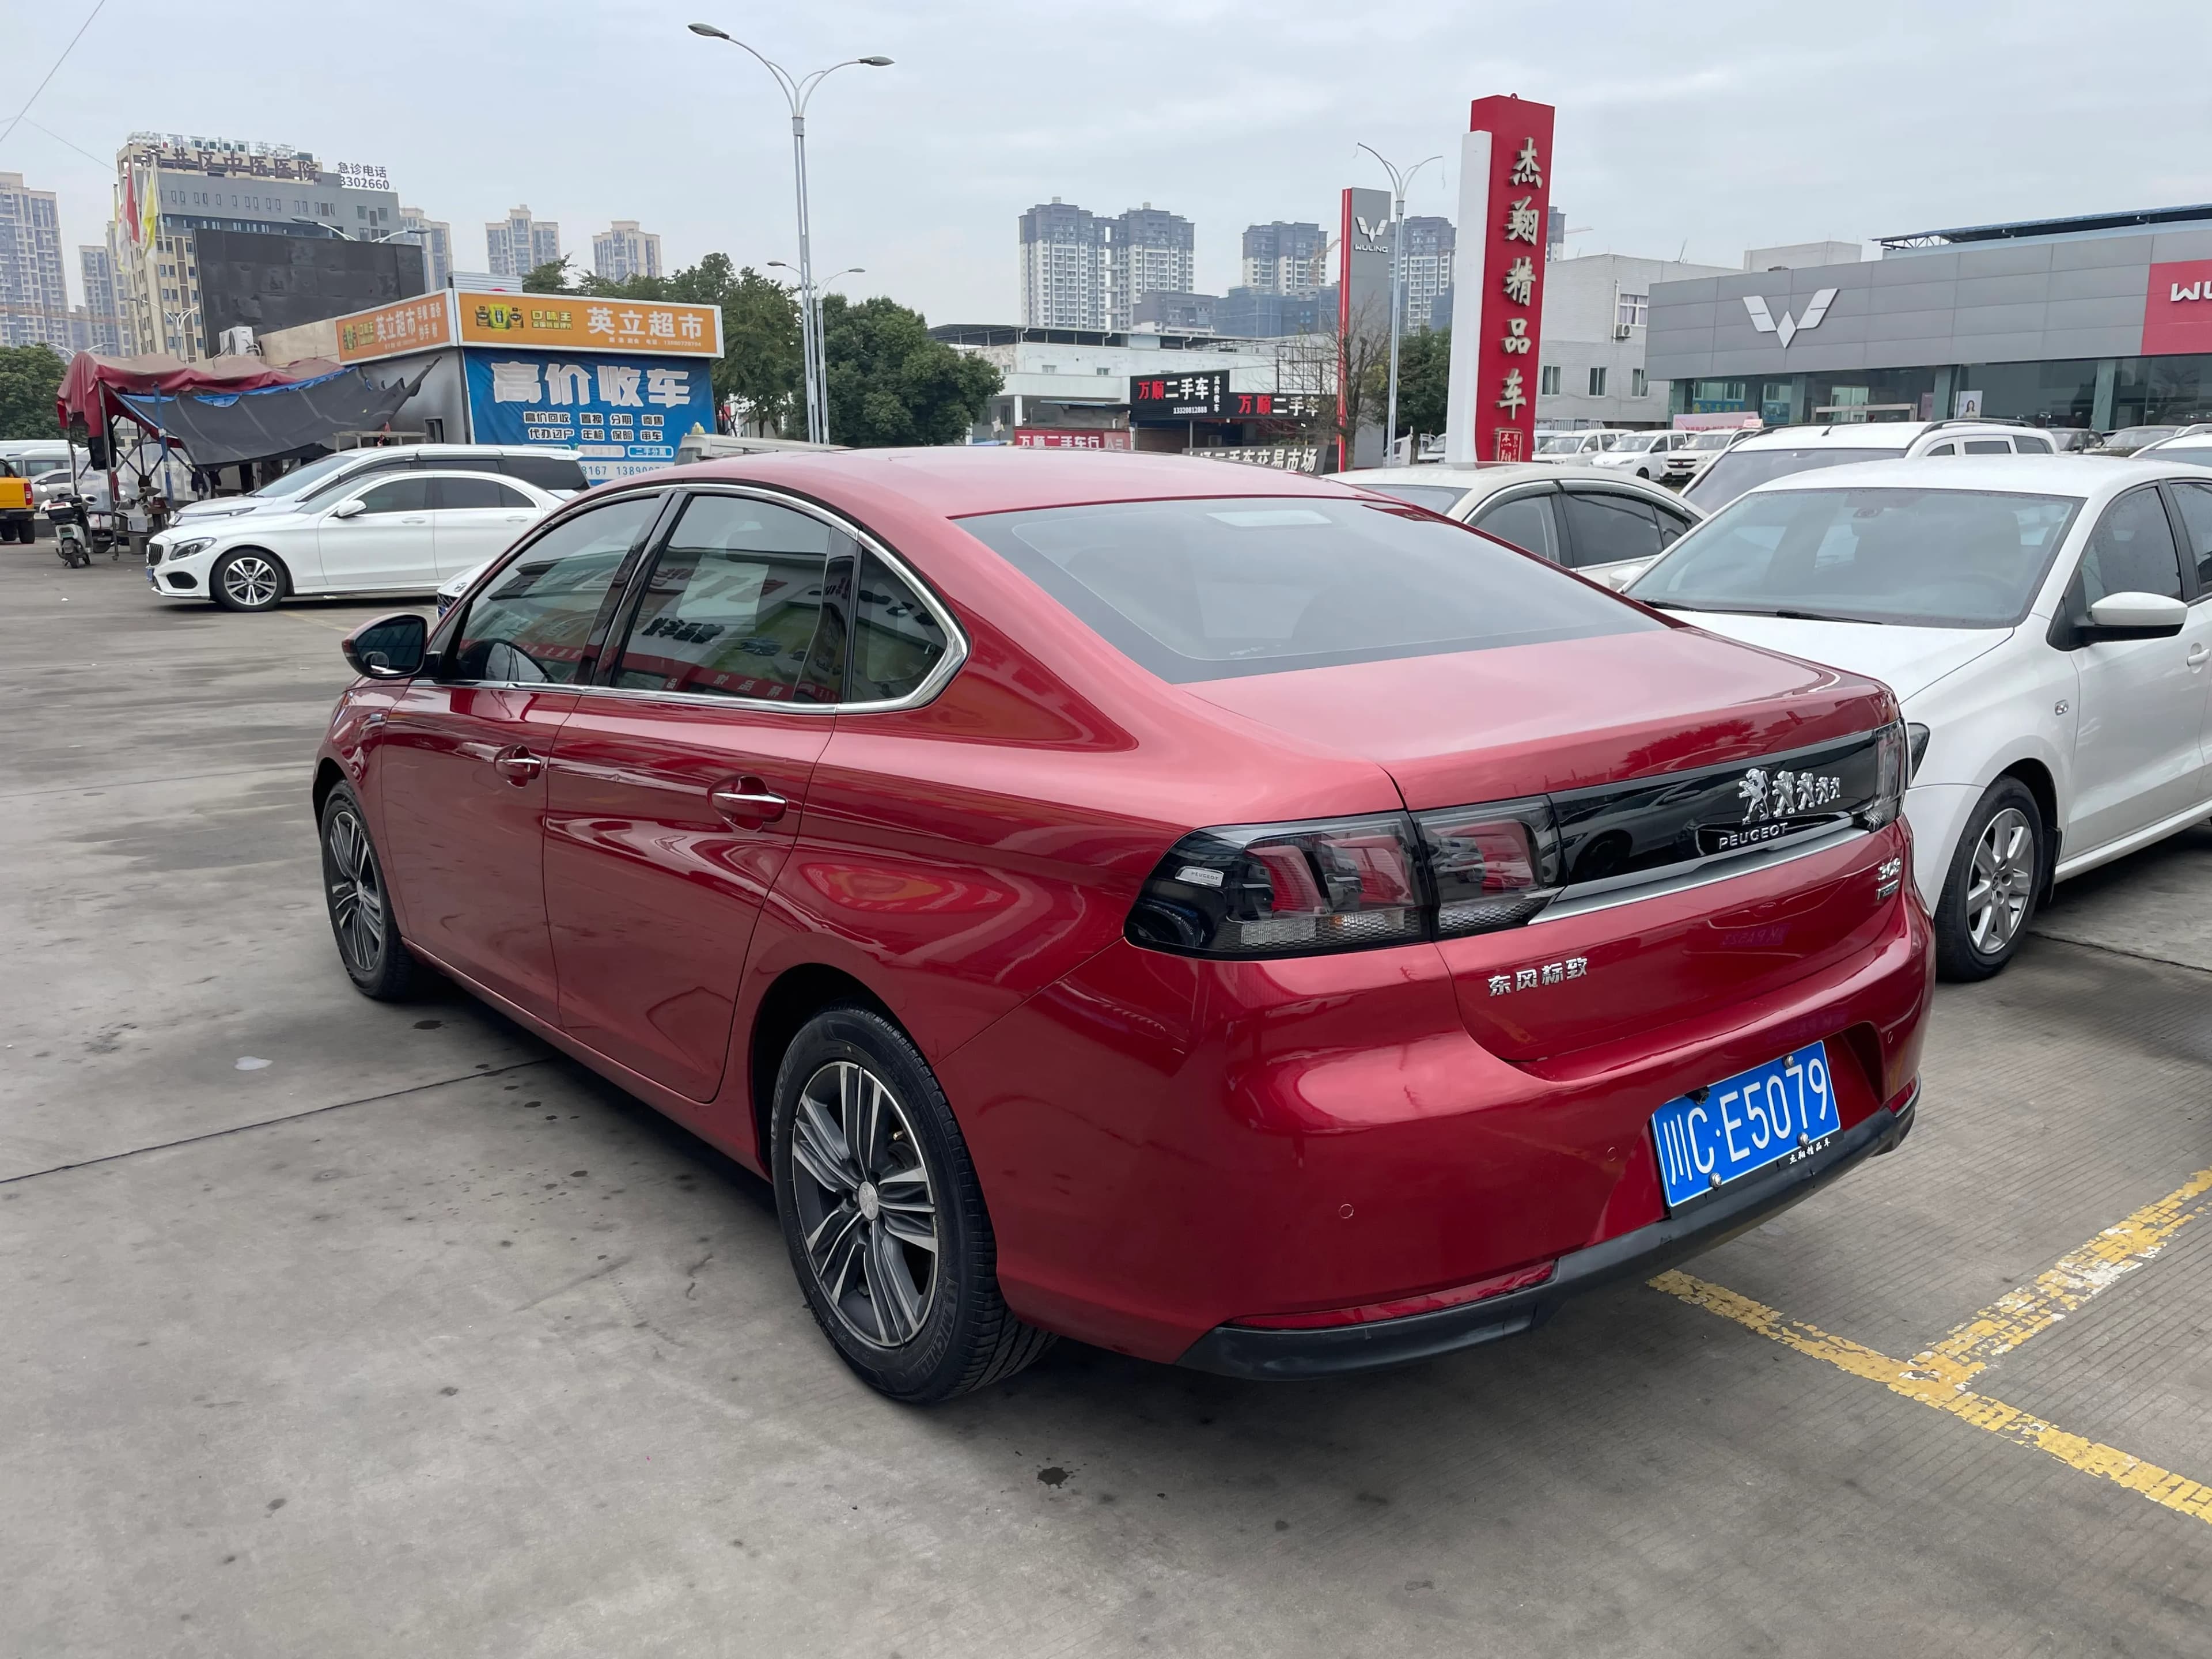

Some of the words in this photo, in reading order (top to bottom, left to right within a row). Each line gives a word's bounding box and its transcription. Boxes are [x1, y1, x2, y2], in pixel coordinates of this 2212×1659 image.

[338, 161, 387, 178] 急诊电话
[1354, 244, 1388, 253] WULING
[1497, 137, 1543, 421] 杰翔精品车
[376, 308, 415, 343] 英立超市
[532, 310, 571, 321] 口味王
[586, 307, 704, 339] 英立超市
[491, 361, 691, 408] 高价收车
[1138, 377, 1209, 400] 万顺二手车
[1238, 395, 1319, 417] 万顺二手车
[524, 412, 570, 423] 高价回收
[580, 413, 604, 425] 置换
[611, 414, 633, 425] 分期
[642, 415, 664, 426] 寄售
[529, 429, 574, 440] 代办过户
[581, 429, 604, 440] 年检
[611, 430, 634, 441] 保险
[641, 430, 663, 441] 审车
[616, 466, 666, 475] 13890
[1190, 448, 1318, 472] 手车交易市场
[1719, 823, 1788, 850] PEUGEOT
[1191, 871, 1219, 880] PEUGEOT
[1487, 957, 1588, 997] 东风标致
